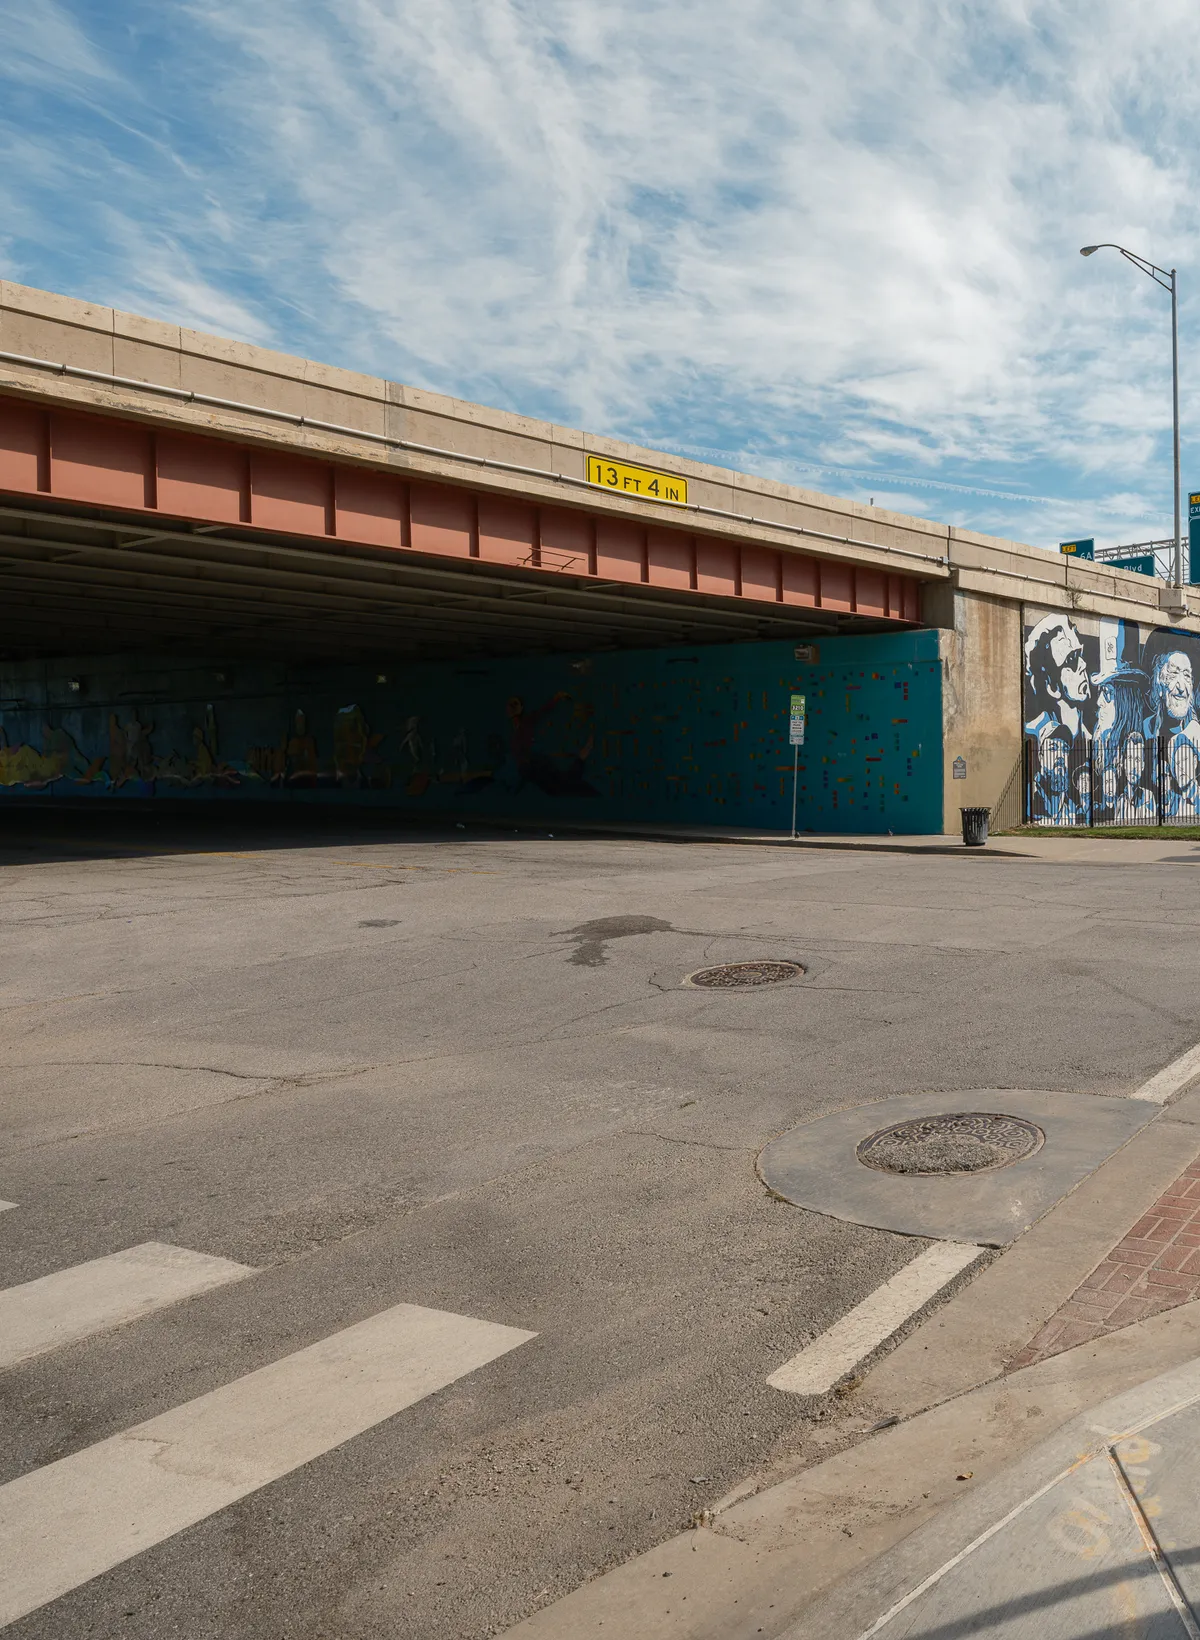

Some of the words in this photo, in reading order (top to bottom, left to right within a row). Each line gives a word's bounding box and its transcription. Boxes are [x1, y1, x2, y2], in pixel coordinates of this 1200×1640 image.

[596, 465, 618, 486] 13
[623, 477, 641, 491] FT
[647, 479, 660, 496] 4
[665, 487, 679, 501] IN
[1080, 551, 1093, 560] 6A
